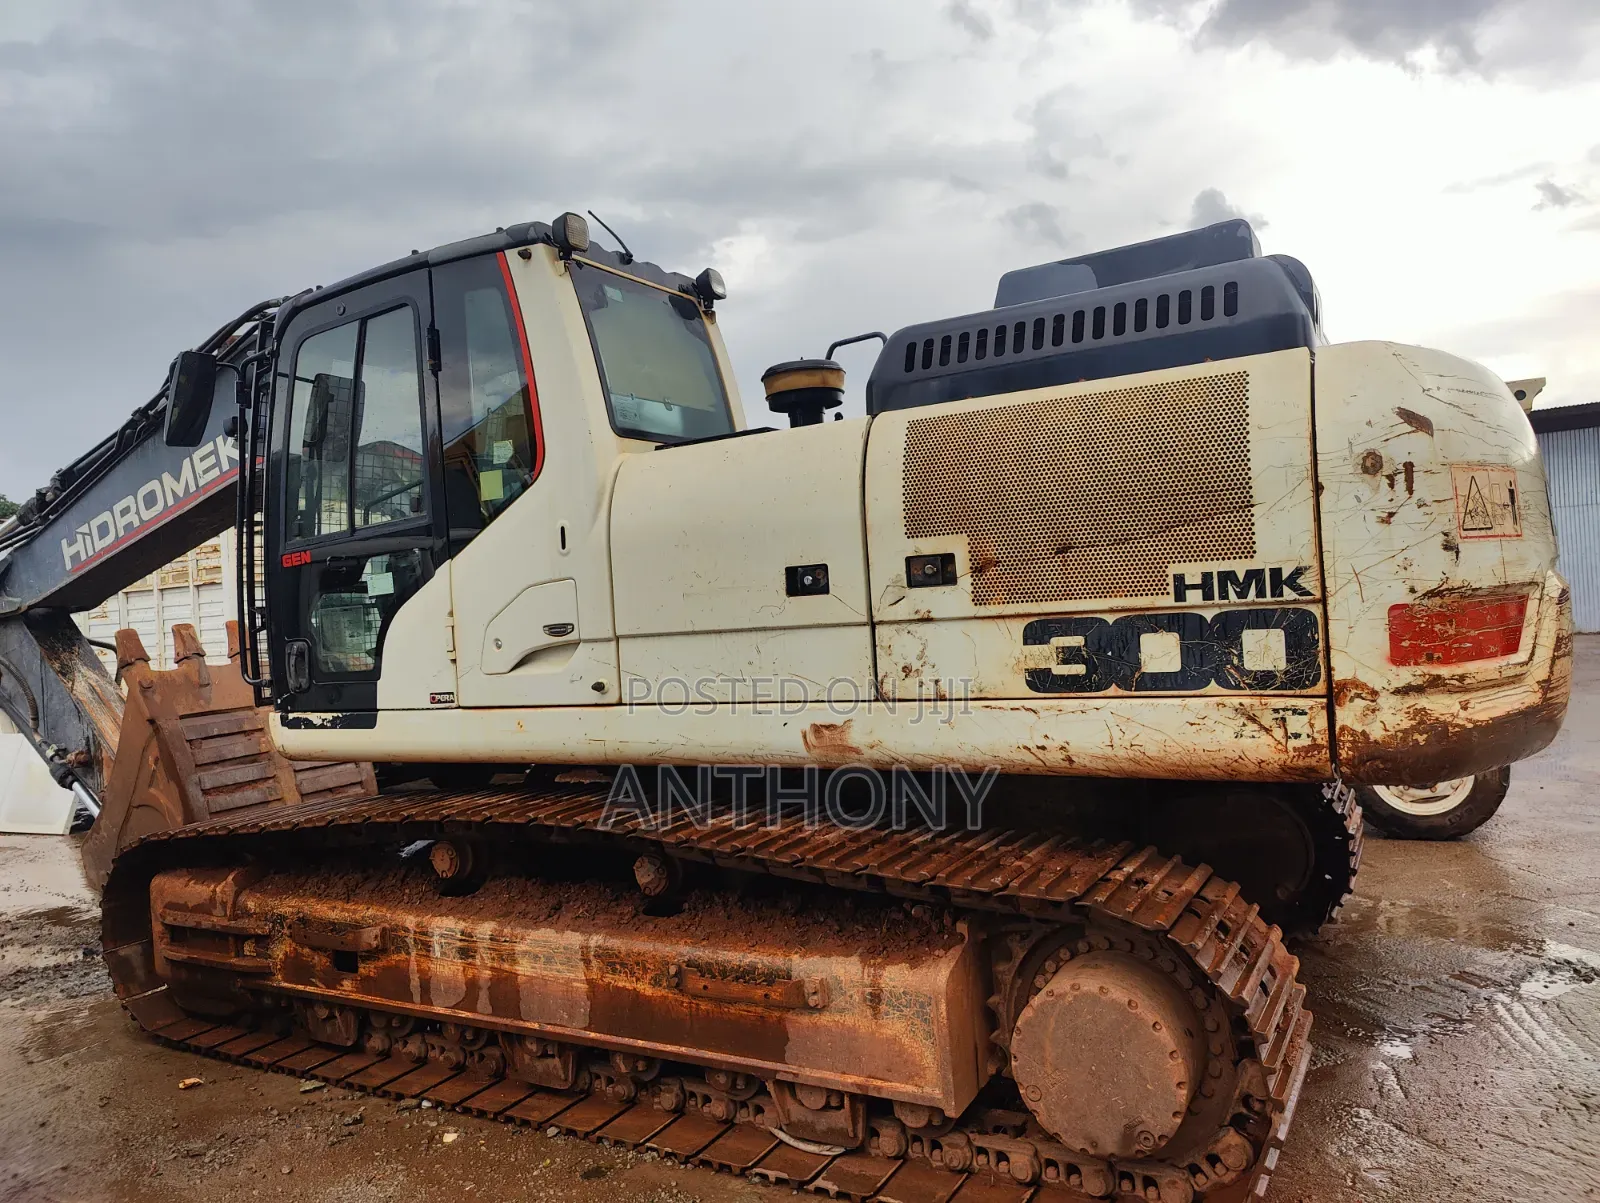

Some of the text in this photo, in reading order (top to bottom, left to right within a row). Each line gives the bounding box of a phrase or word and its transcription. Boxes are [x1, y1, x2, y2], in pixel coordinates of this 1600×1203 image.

[282, 550, 312, 568] GEN
[1173, 565, 1315, 602] HMK
[1023, 609, 1321, 693] 300
